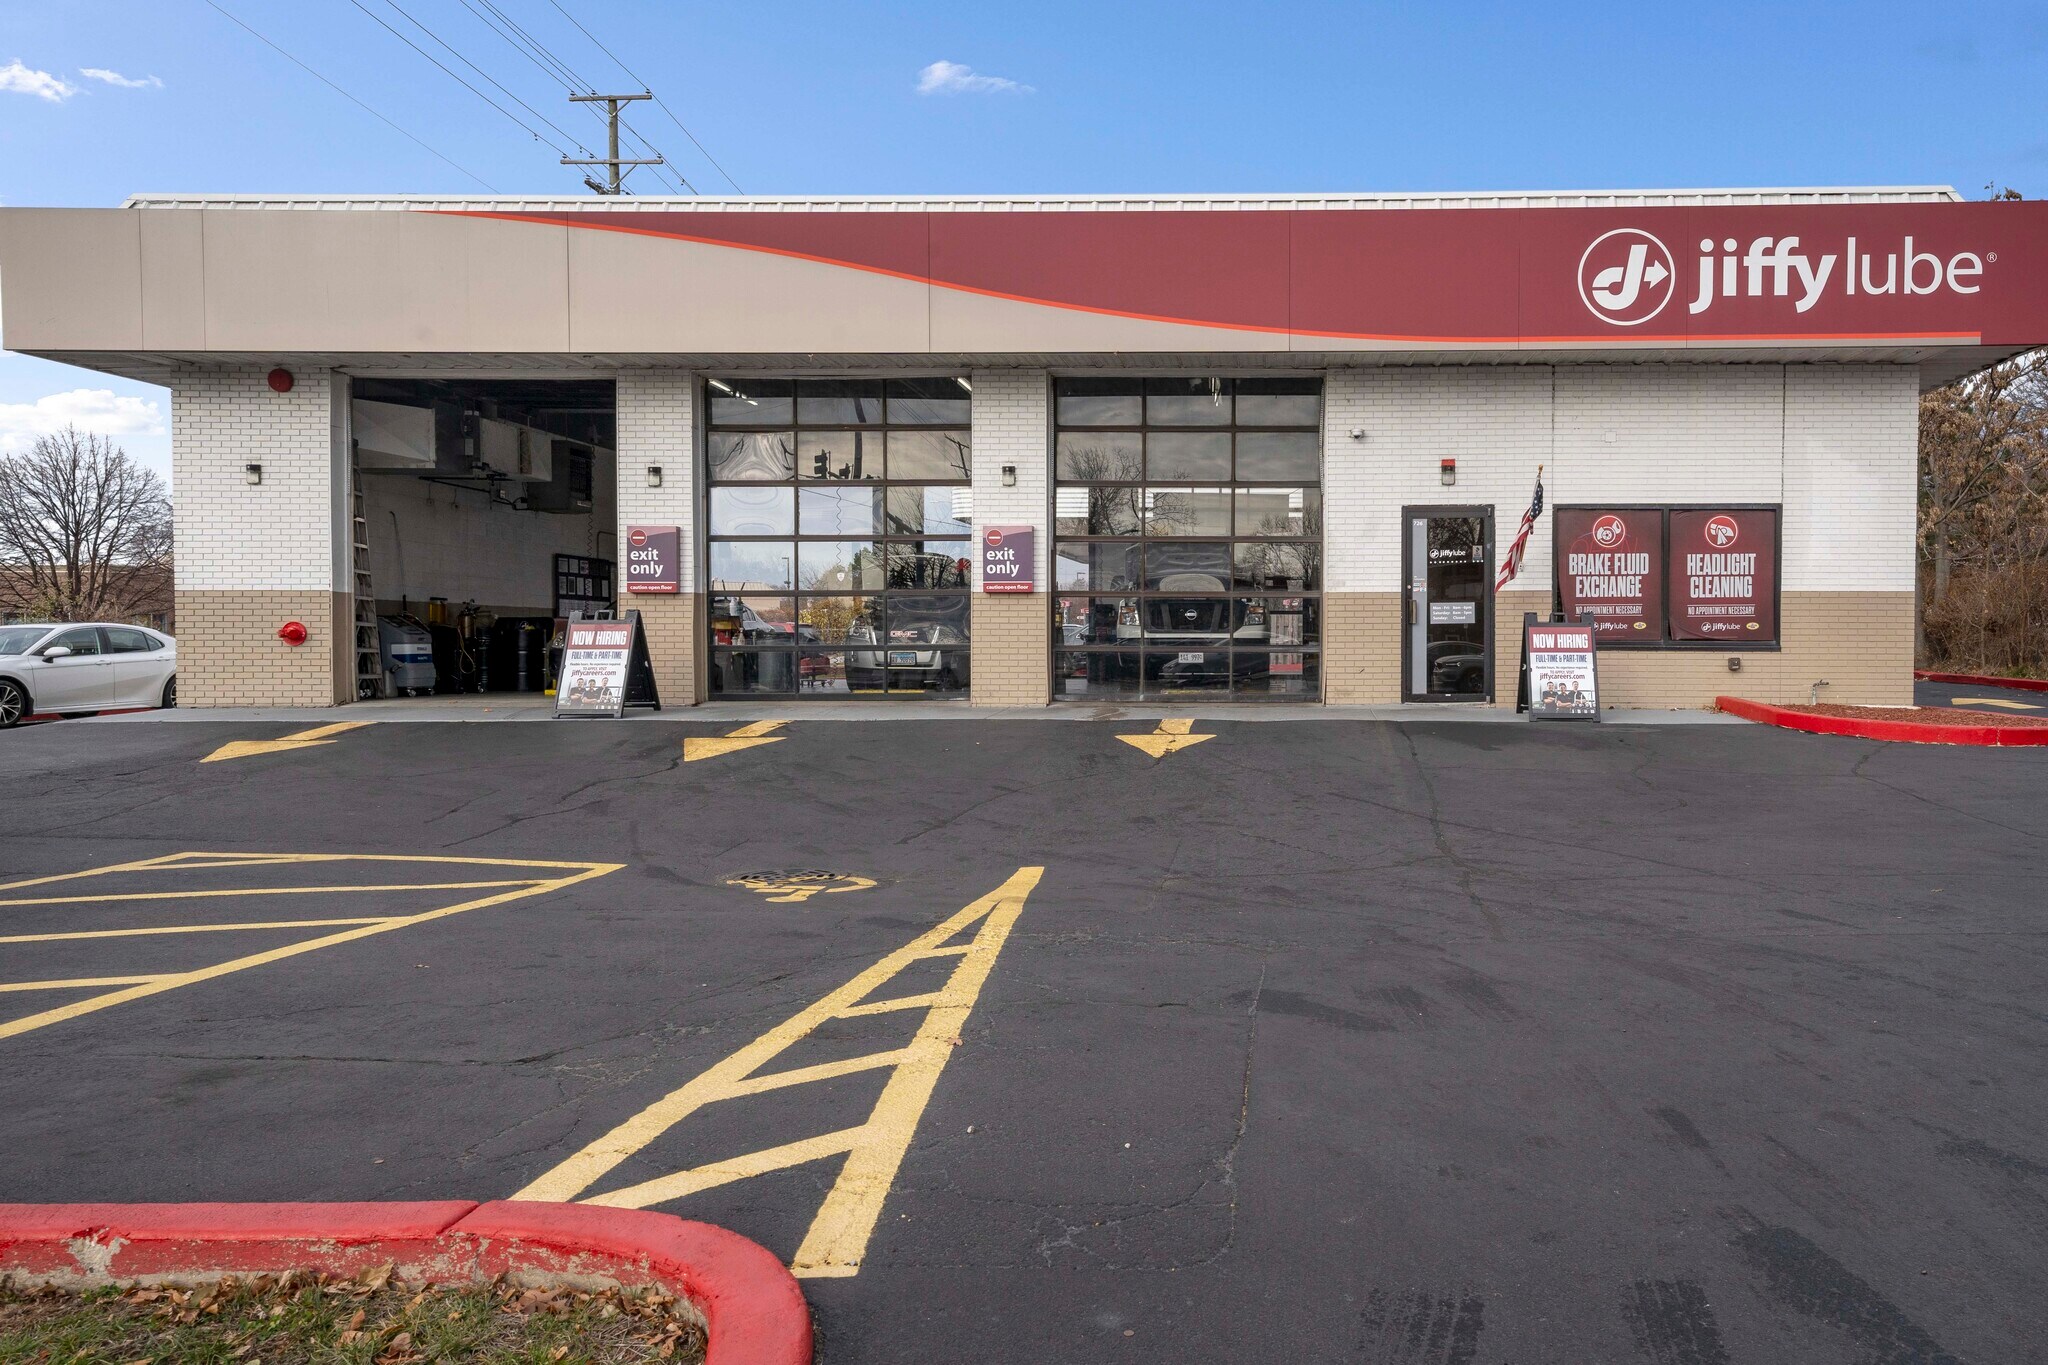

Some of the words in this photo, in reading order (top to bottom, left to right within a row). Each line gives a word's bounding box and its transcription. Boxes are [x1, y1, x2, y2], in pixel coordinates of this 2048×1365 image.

[630, 547, 658, 560] exit
[986, 547, 1014, 560] exit
[630, 561, 664, 578] only
[986, 560, 1020, 578] only
[1568, 553, 1612, 576] BRAKE
[1614, 552, 1650, 575] FLUID
[1686, 553, 1756, 576] HEADLIGHT
[1575, 576, 1643, 598] EXCHANGE
[1690, 576, 1752, 598] CLEANING
[1575, 606, 1582, 614] NO
[1583, 606, 1615, 614] APPOINTMENT
[1616, 606, 1642, 614] NECESSARY
[1688, 606, 1695, 615] NO
[1696, 606, 1727, 615] APPOINTMENT
[1728, 606, 1755, 614] NECESSARY
[572, 631, 595, 646] NOW
[596, 630, 627, 646] HIRING
[1532, 634, 1555, 648] NOW
[1557, 634, 1588, 648] HIRING
[571, 651, 594, 659] FULL-TIME
[598, 651, 622, 659] PART-TIME
